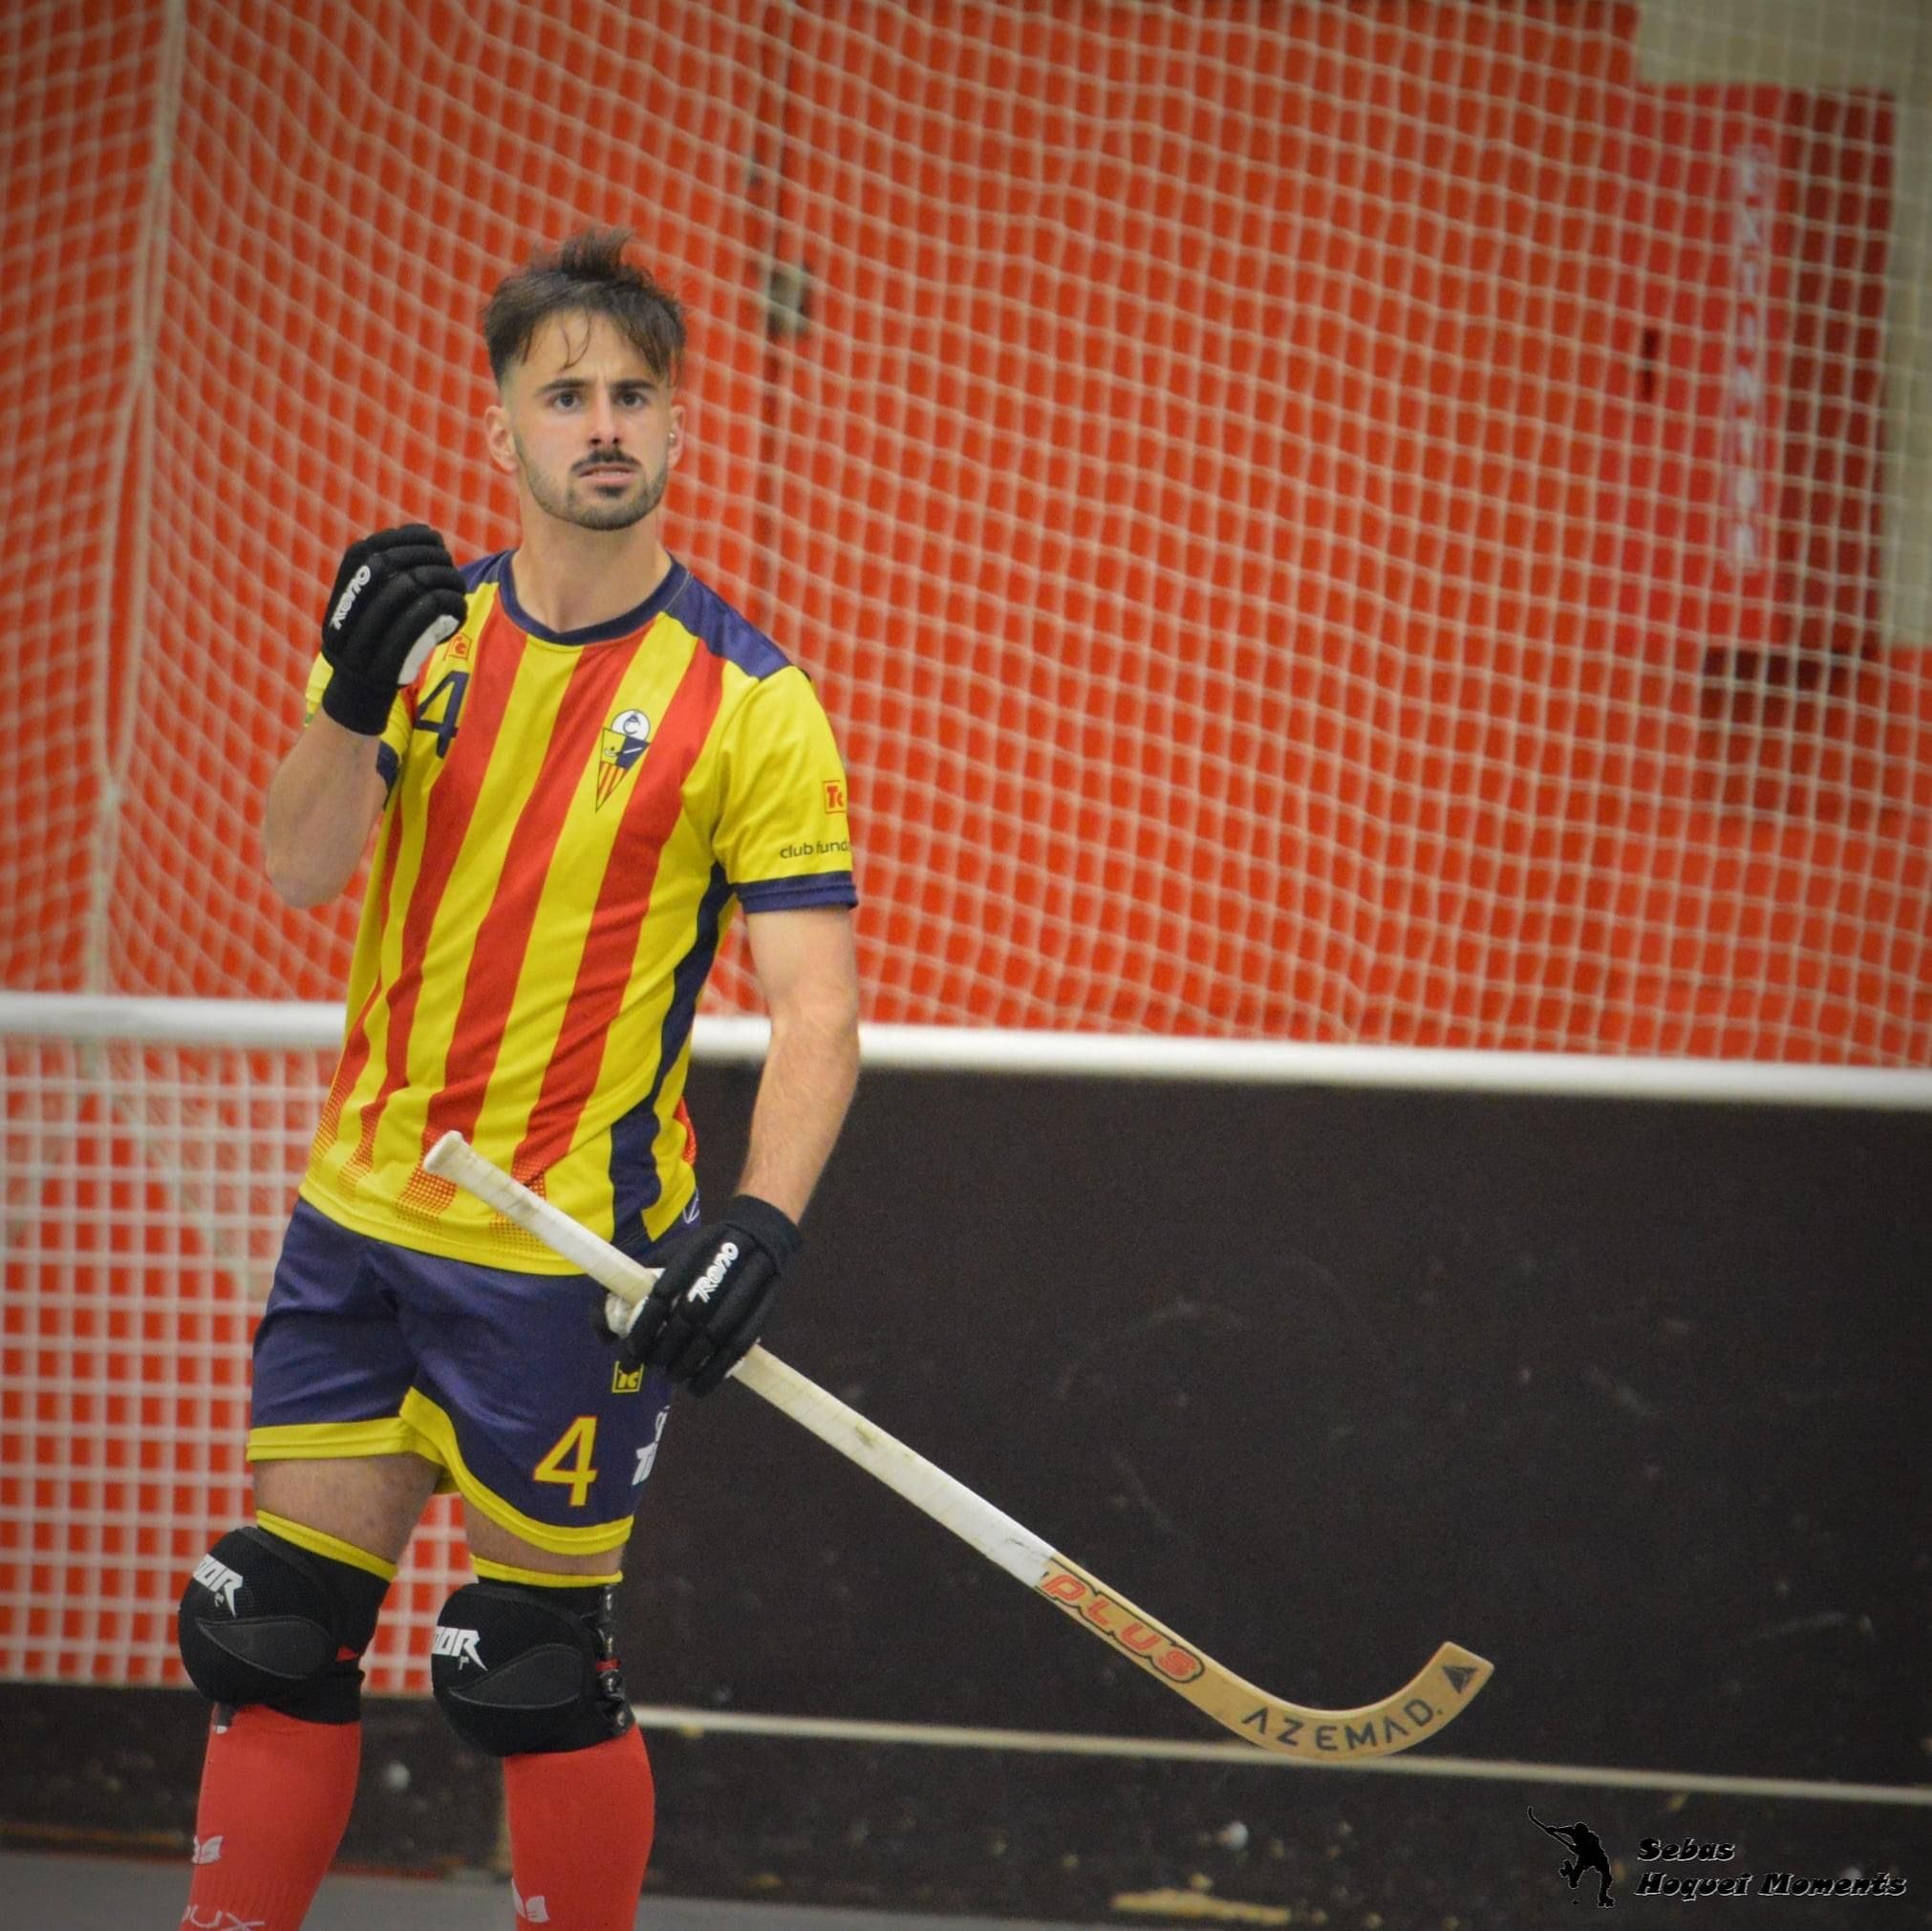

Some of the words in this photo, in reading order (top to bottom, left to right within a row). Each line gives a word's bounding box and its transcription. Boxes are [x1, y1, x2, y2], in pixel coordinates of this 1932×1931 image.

[413, 670, 470, 760] 4
[780, 843, 814, 859] club
[531, 1414, 599, 1508] 4
[1041, 1574, 1198, 1677] PLUS
